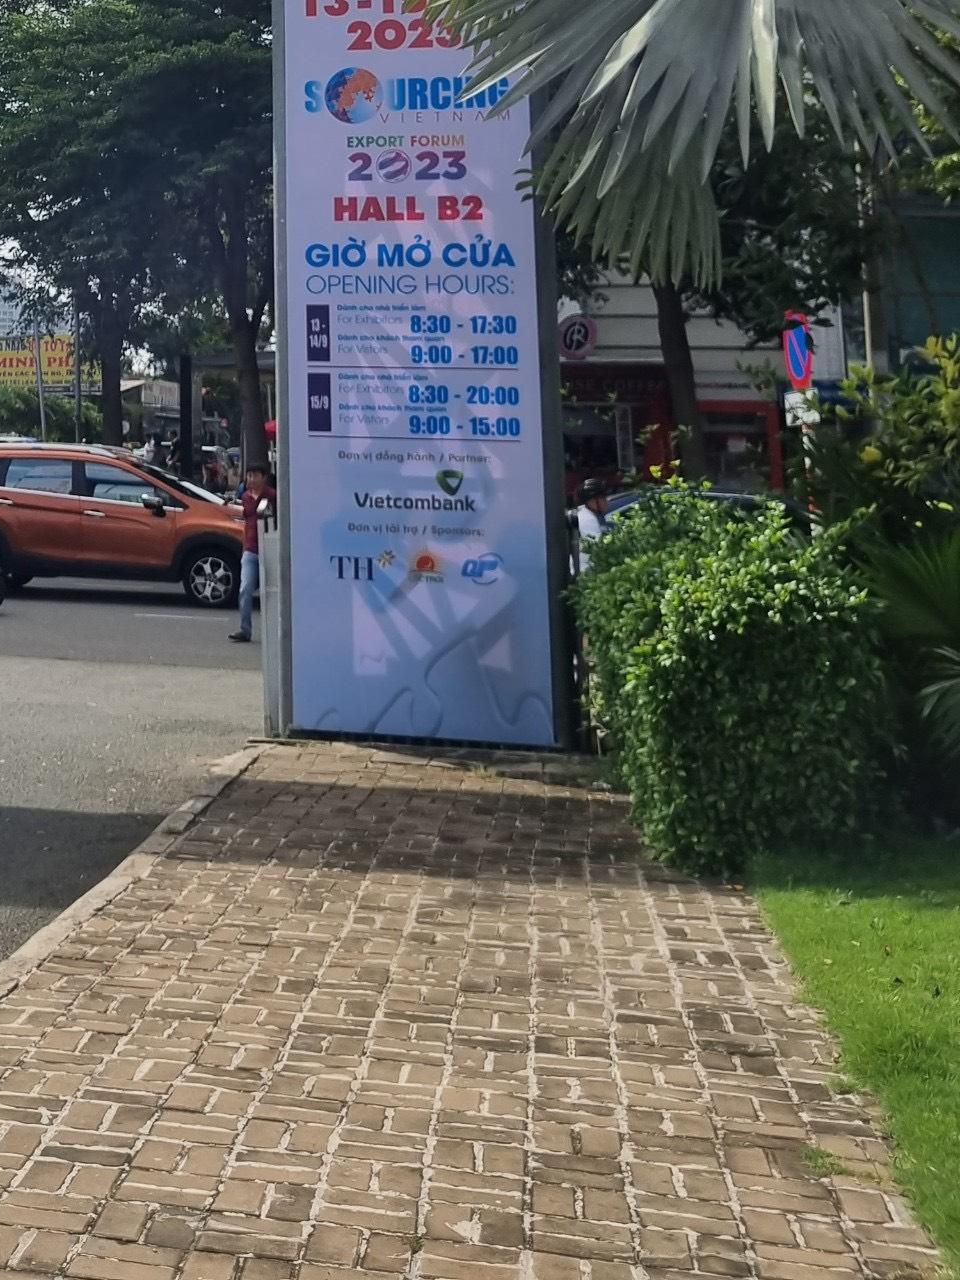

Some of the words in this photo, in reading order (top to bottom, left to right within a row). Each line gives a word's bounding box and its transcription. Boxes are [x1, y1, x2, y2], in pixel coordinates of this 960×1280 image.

[347, 135, 404, 148] EXPORT
[410, 134, 465, 147] FORUM
[348, 149, 467, 183] 2023
[334, 196, 425, 221] HALL
[438, 195, 483, 221] B2
[305, 237, 367, 268] GIỜ
[377, 234, 432, 268] MỞ
[442, 234, 515, 268] CỬA
[306, 275, 417, 294] OPENING
[425, 274, 515, 295] HOURS:
[311, 318, 320, 331] 13
[410, 315, 451, 334] 8:30
[470, 315, 517, 334] 17:30
[309, 335, 328, 348] 14/9
[411, 345, 452, 364] 9:00
[471, 346, 518, 364] 17:00
[310, 395, 329, 410] 15/9
[408, 384, 449, 404] 8:30
[466, 385, 519, 405] 20:00
[409, 415, 450, 435] 9:00
[470, 416, 520, 436] 15:00
[354, 492, 475, 512] Vietcombank
[330, 555, 376, 581] TH
